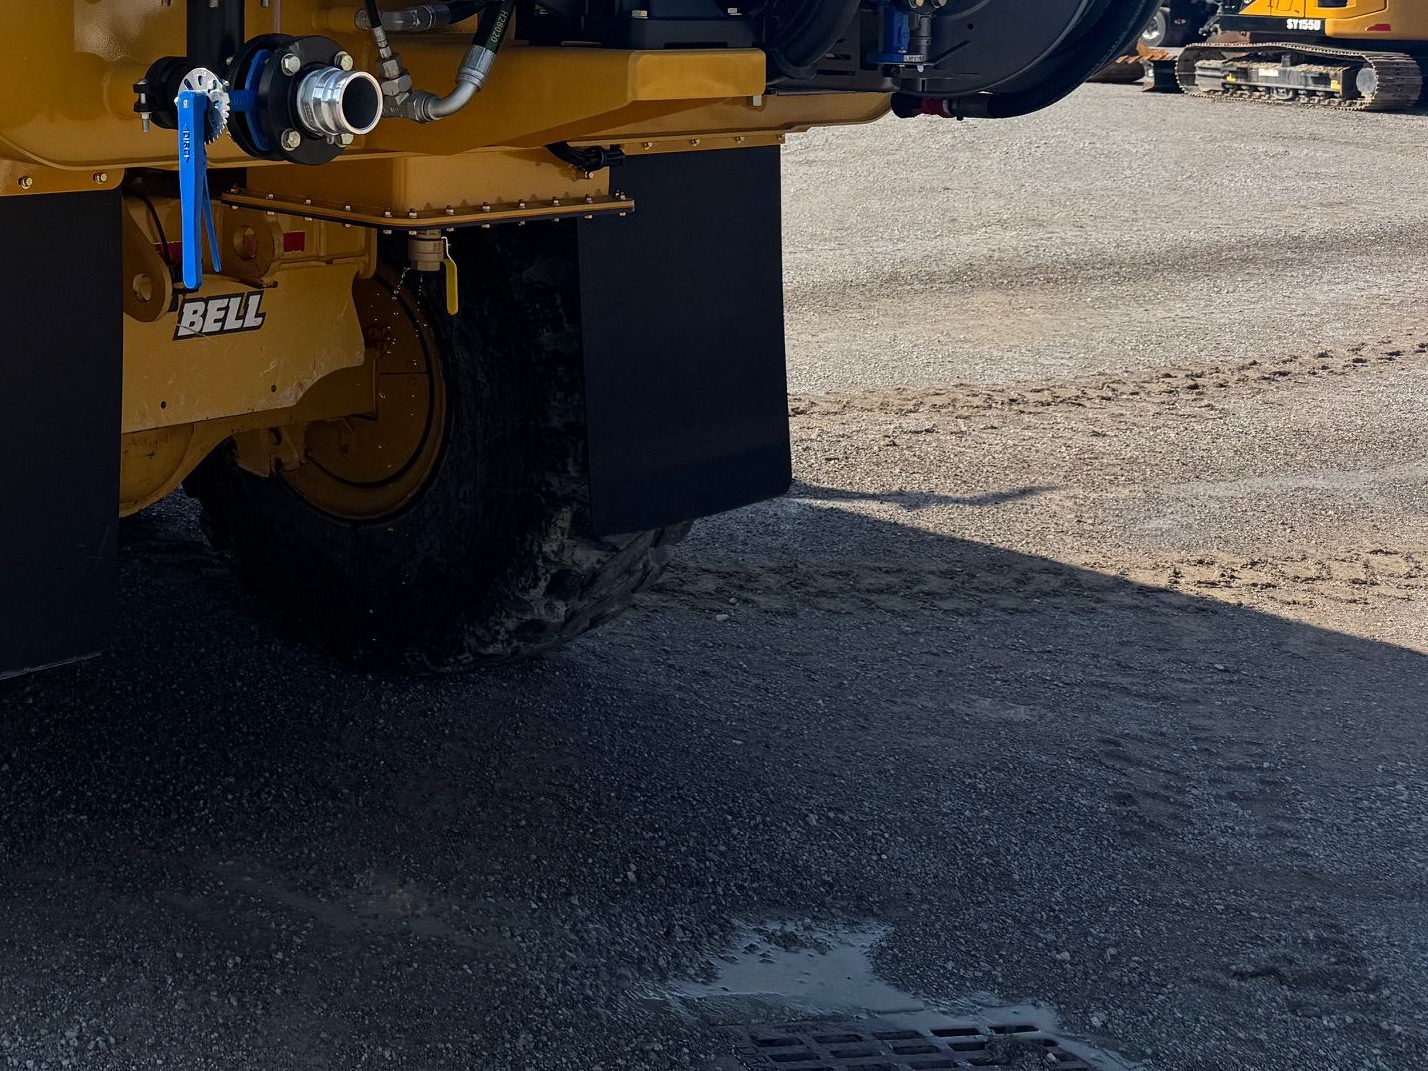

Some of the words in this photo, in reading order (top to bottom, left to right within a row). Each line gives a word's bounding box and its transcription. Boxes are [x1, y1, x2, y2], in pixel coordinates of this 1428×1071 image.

[490, 9, 508, 43] H28020
[1286, 18, 1322, 31] SY155U
[175, 292, 265, 339] BELL
